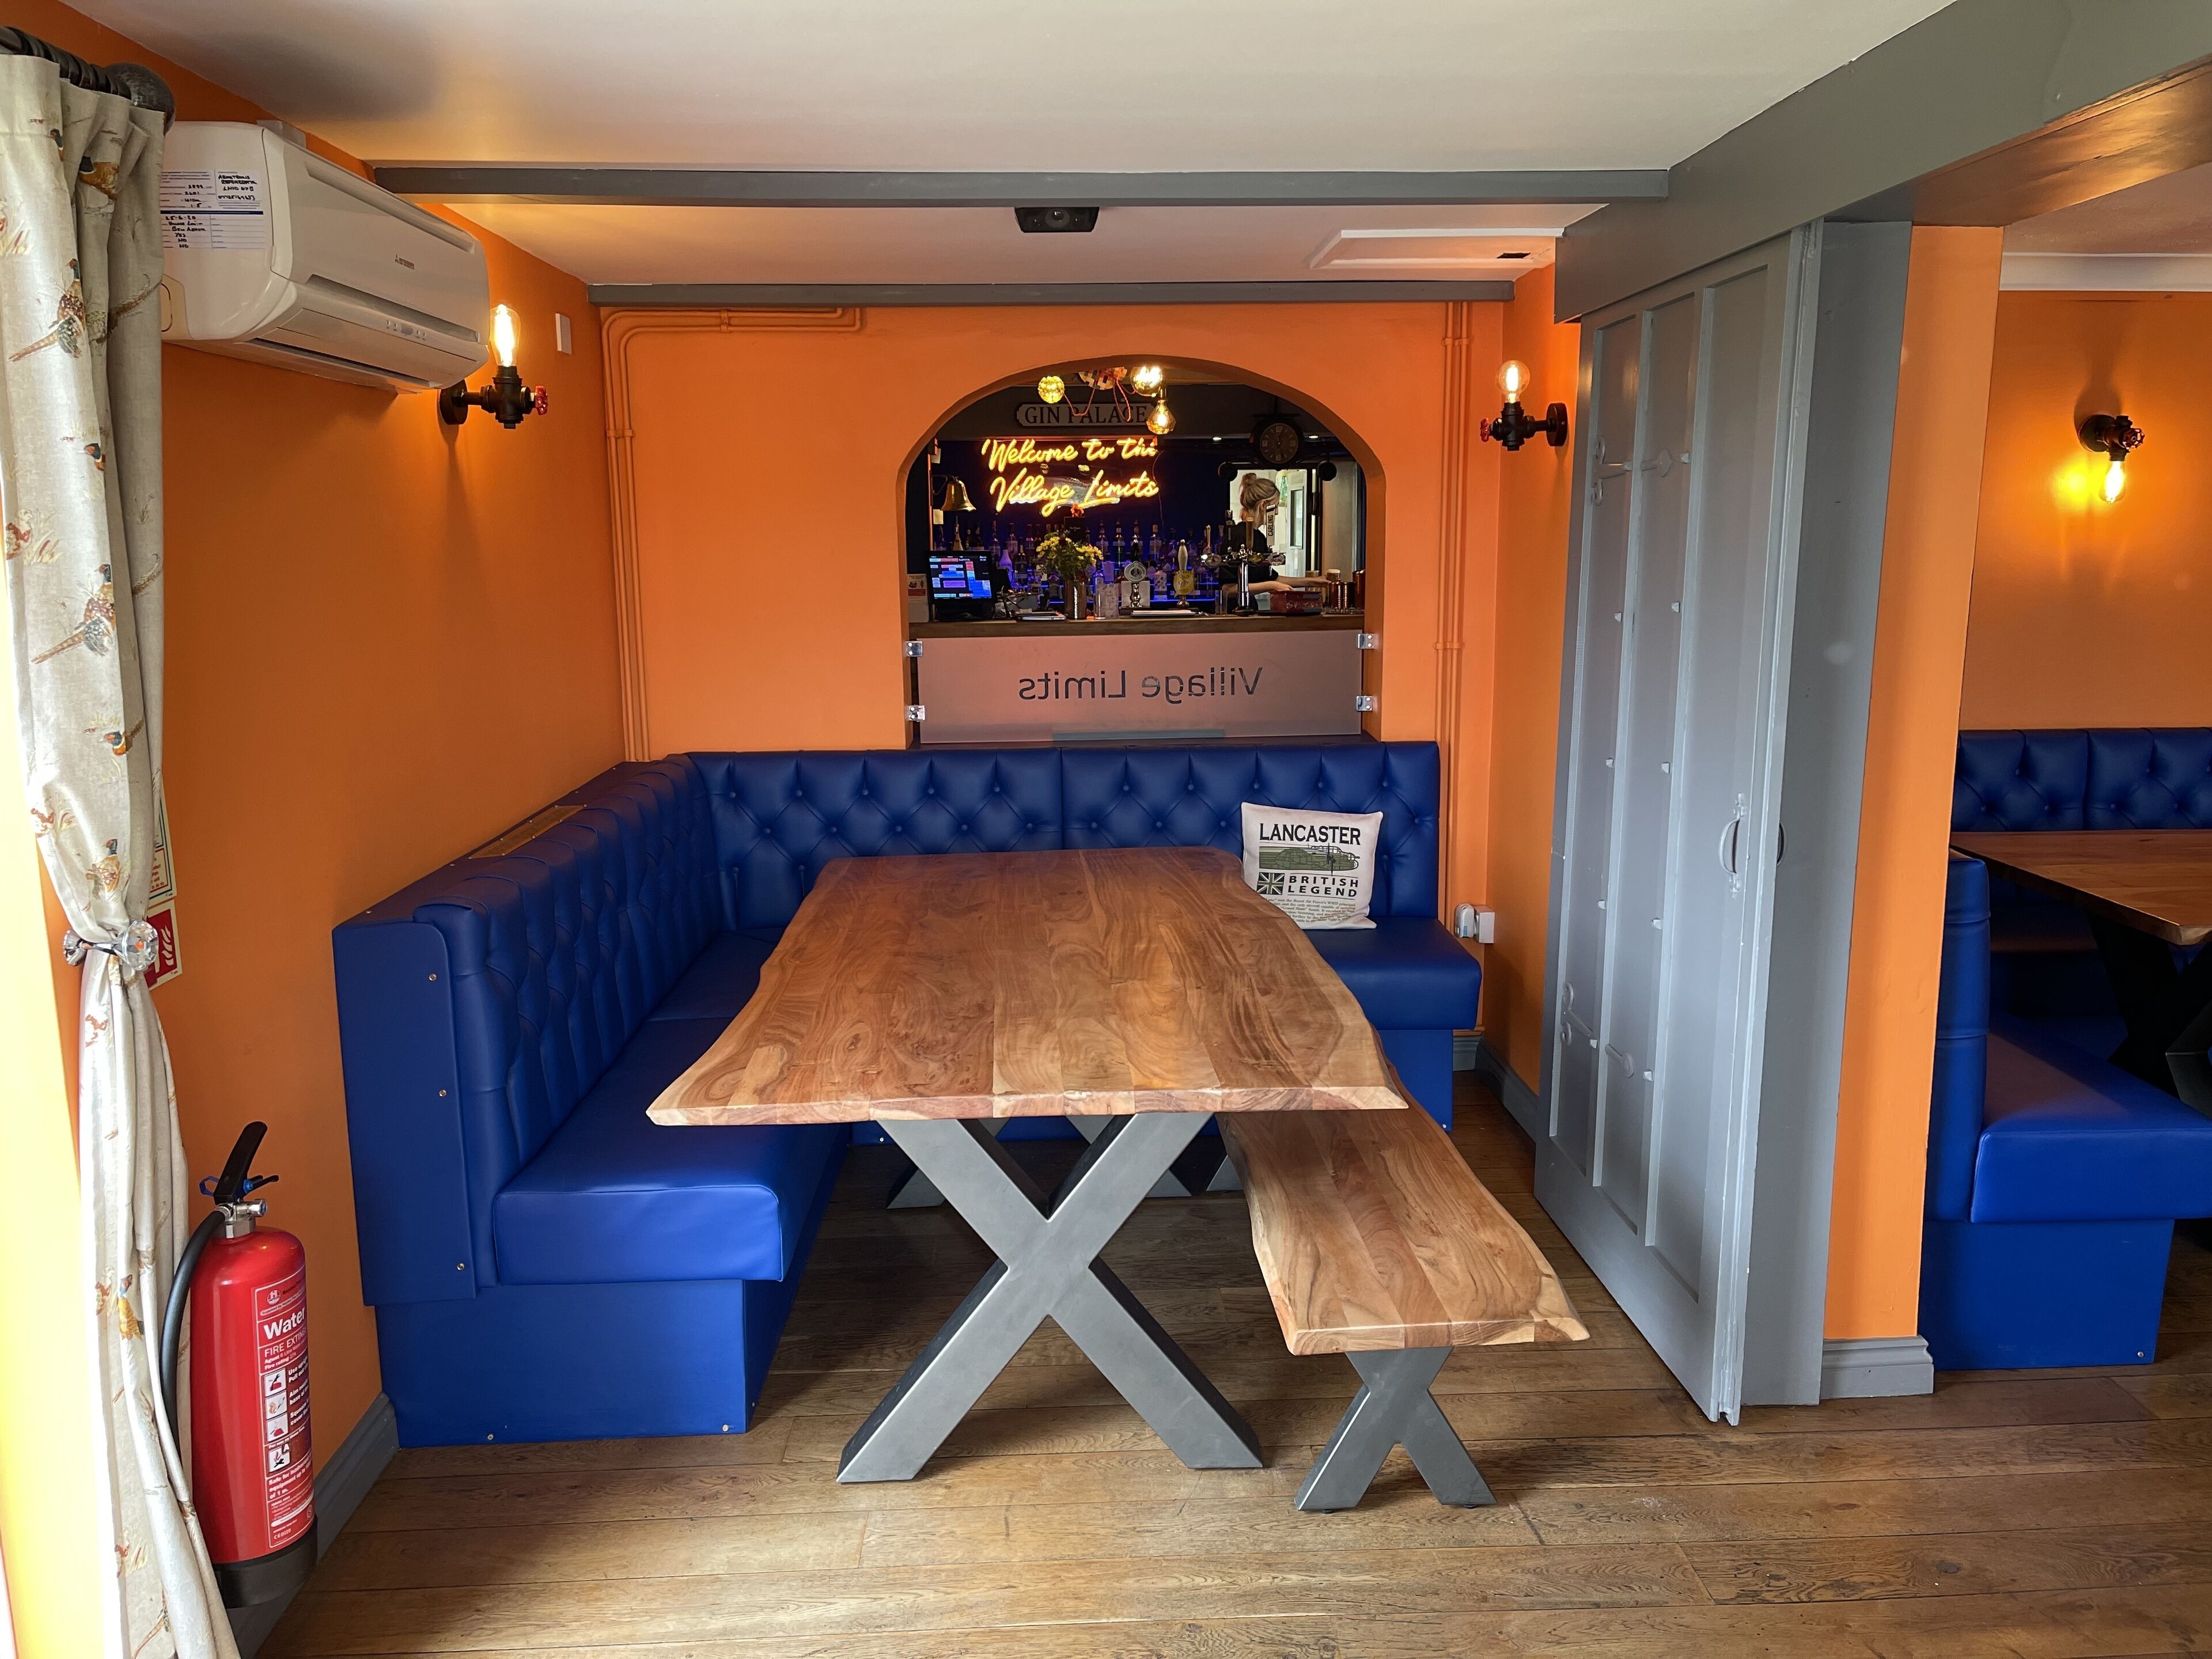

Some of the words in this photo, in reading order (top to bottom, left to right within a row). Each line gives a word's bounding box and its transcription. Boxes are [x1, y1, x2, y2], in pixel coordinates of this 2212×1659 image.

[1025, 406, 1060, 424] GIN
[1068, 406, 1147, 424] PALACE
[981, 438, 1078, 472] Welcome
[1081, 439, 1115, 461] to
[990, 467, 1075, 517] Village
[1077, 469, 1160, 508] Limits
[1259, 823, 1361, 845] LANCASTER
[1289, 876, 1358, 888] BRITISH
[1288, 885, 1357, 897] LEGEND
[263, 1306, 305, 1340] Water
[264, 1342, 285, 1358] FIRE
[264, 1355, 280, 1364] Agent
[264, 1362, 275, 1370] Fire
[288, 1367, 298, 1376] Use
[289, 1388, 299, 1397] Aim
[283, 1444, 290, 1452] A
